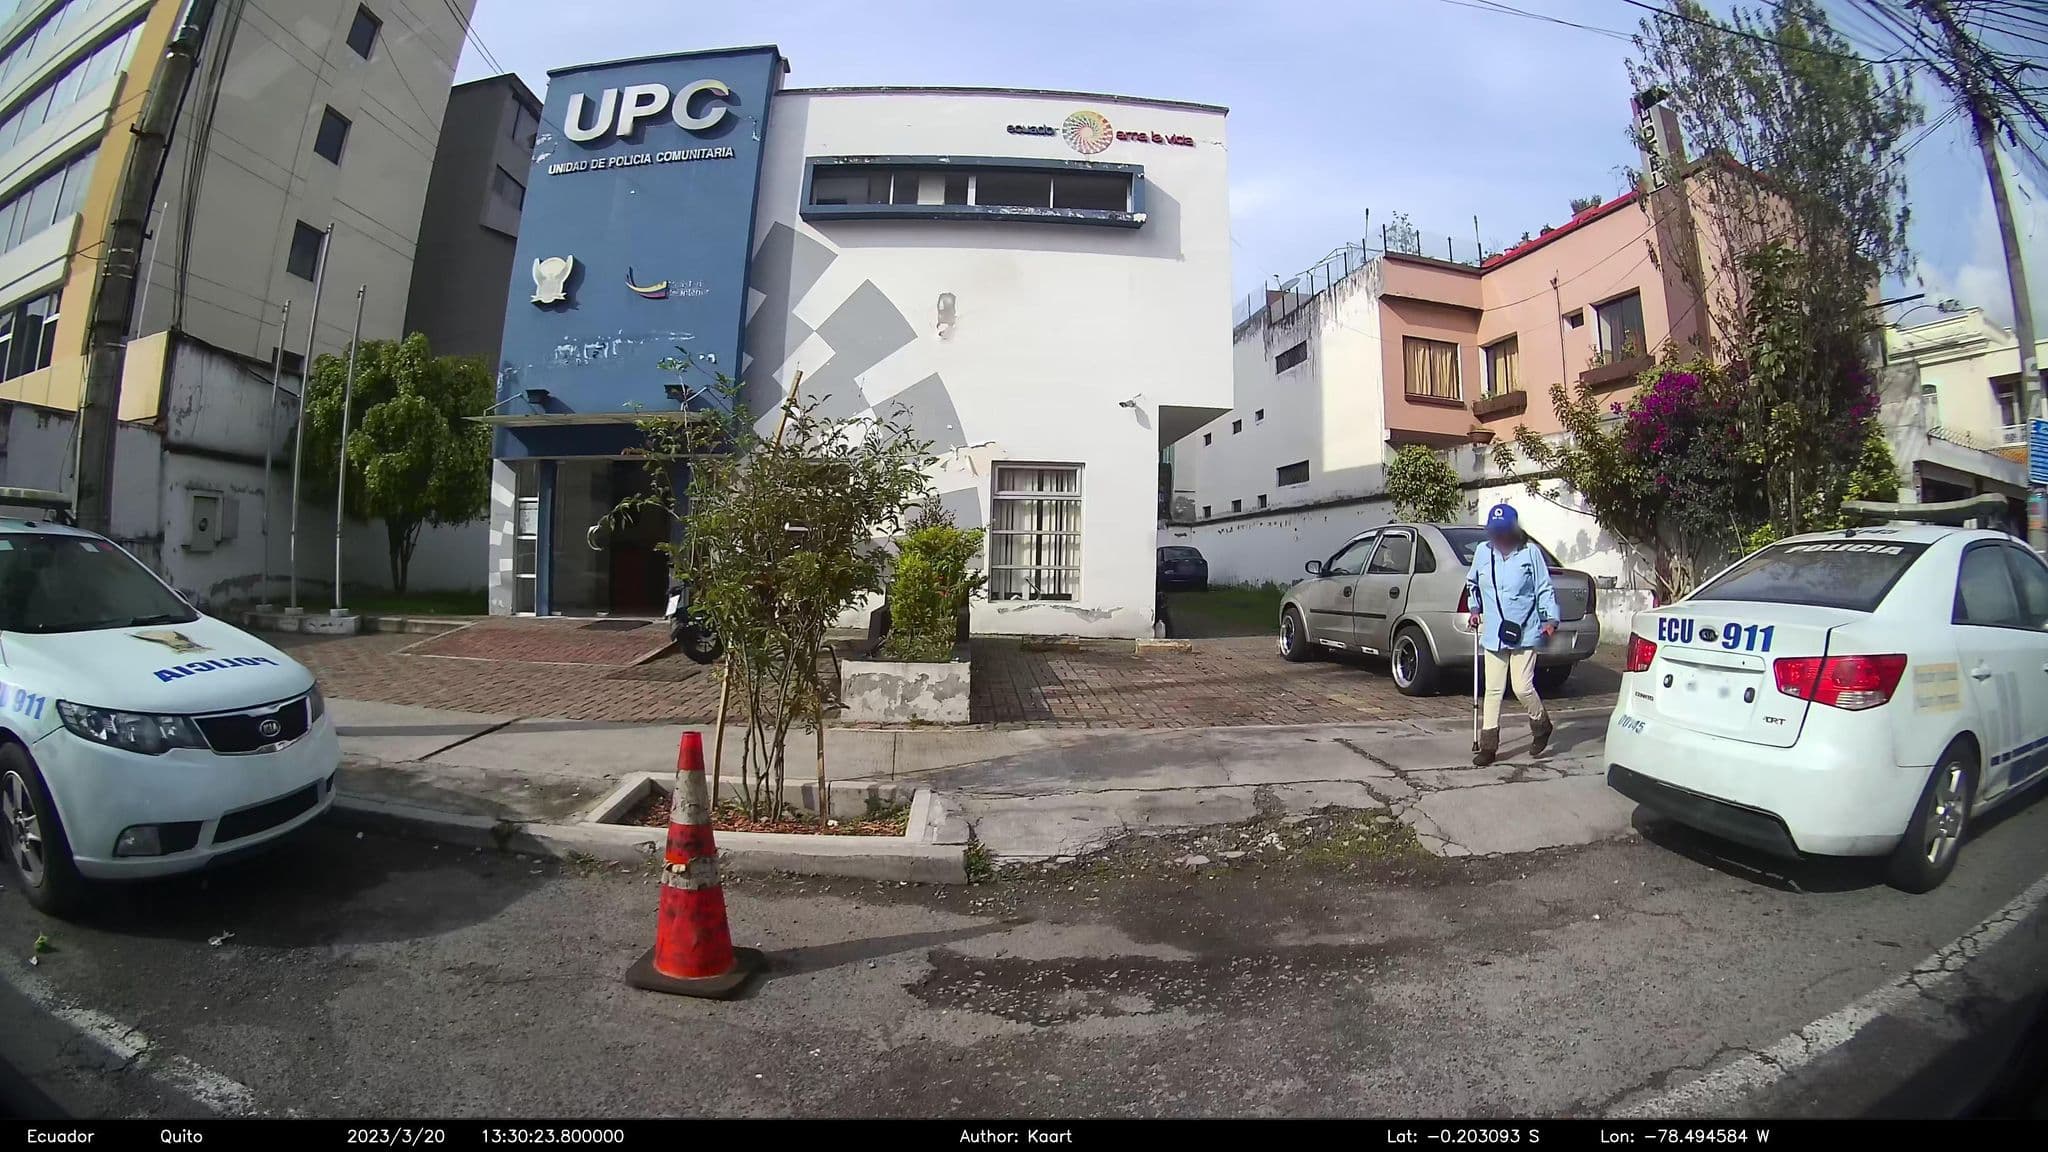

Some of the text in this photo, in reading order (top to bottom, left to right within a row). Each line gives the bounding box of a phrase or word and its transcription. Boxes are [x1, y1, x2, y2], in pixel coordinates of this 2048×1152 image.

[563, 79, 730, 142] UPC
[548, 147, 734, 175] UNIDAD DE POLICIA COMUNITARIA
[1784, 543, 1905, 556] POLICIA
[1658, 617, 1775, 652] ECU 911
[13, 688, 46, 720] 911
